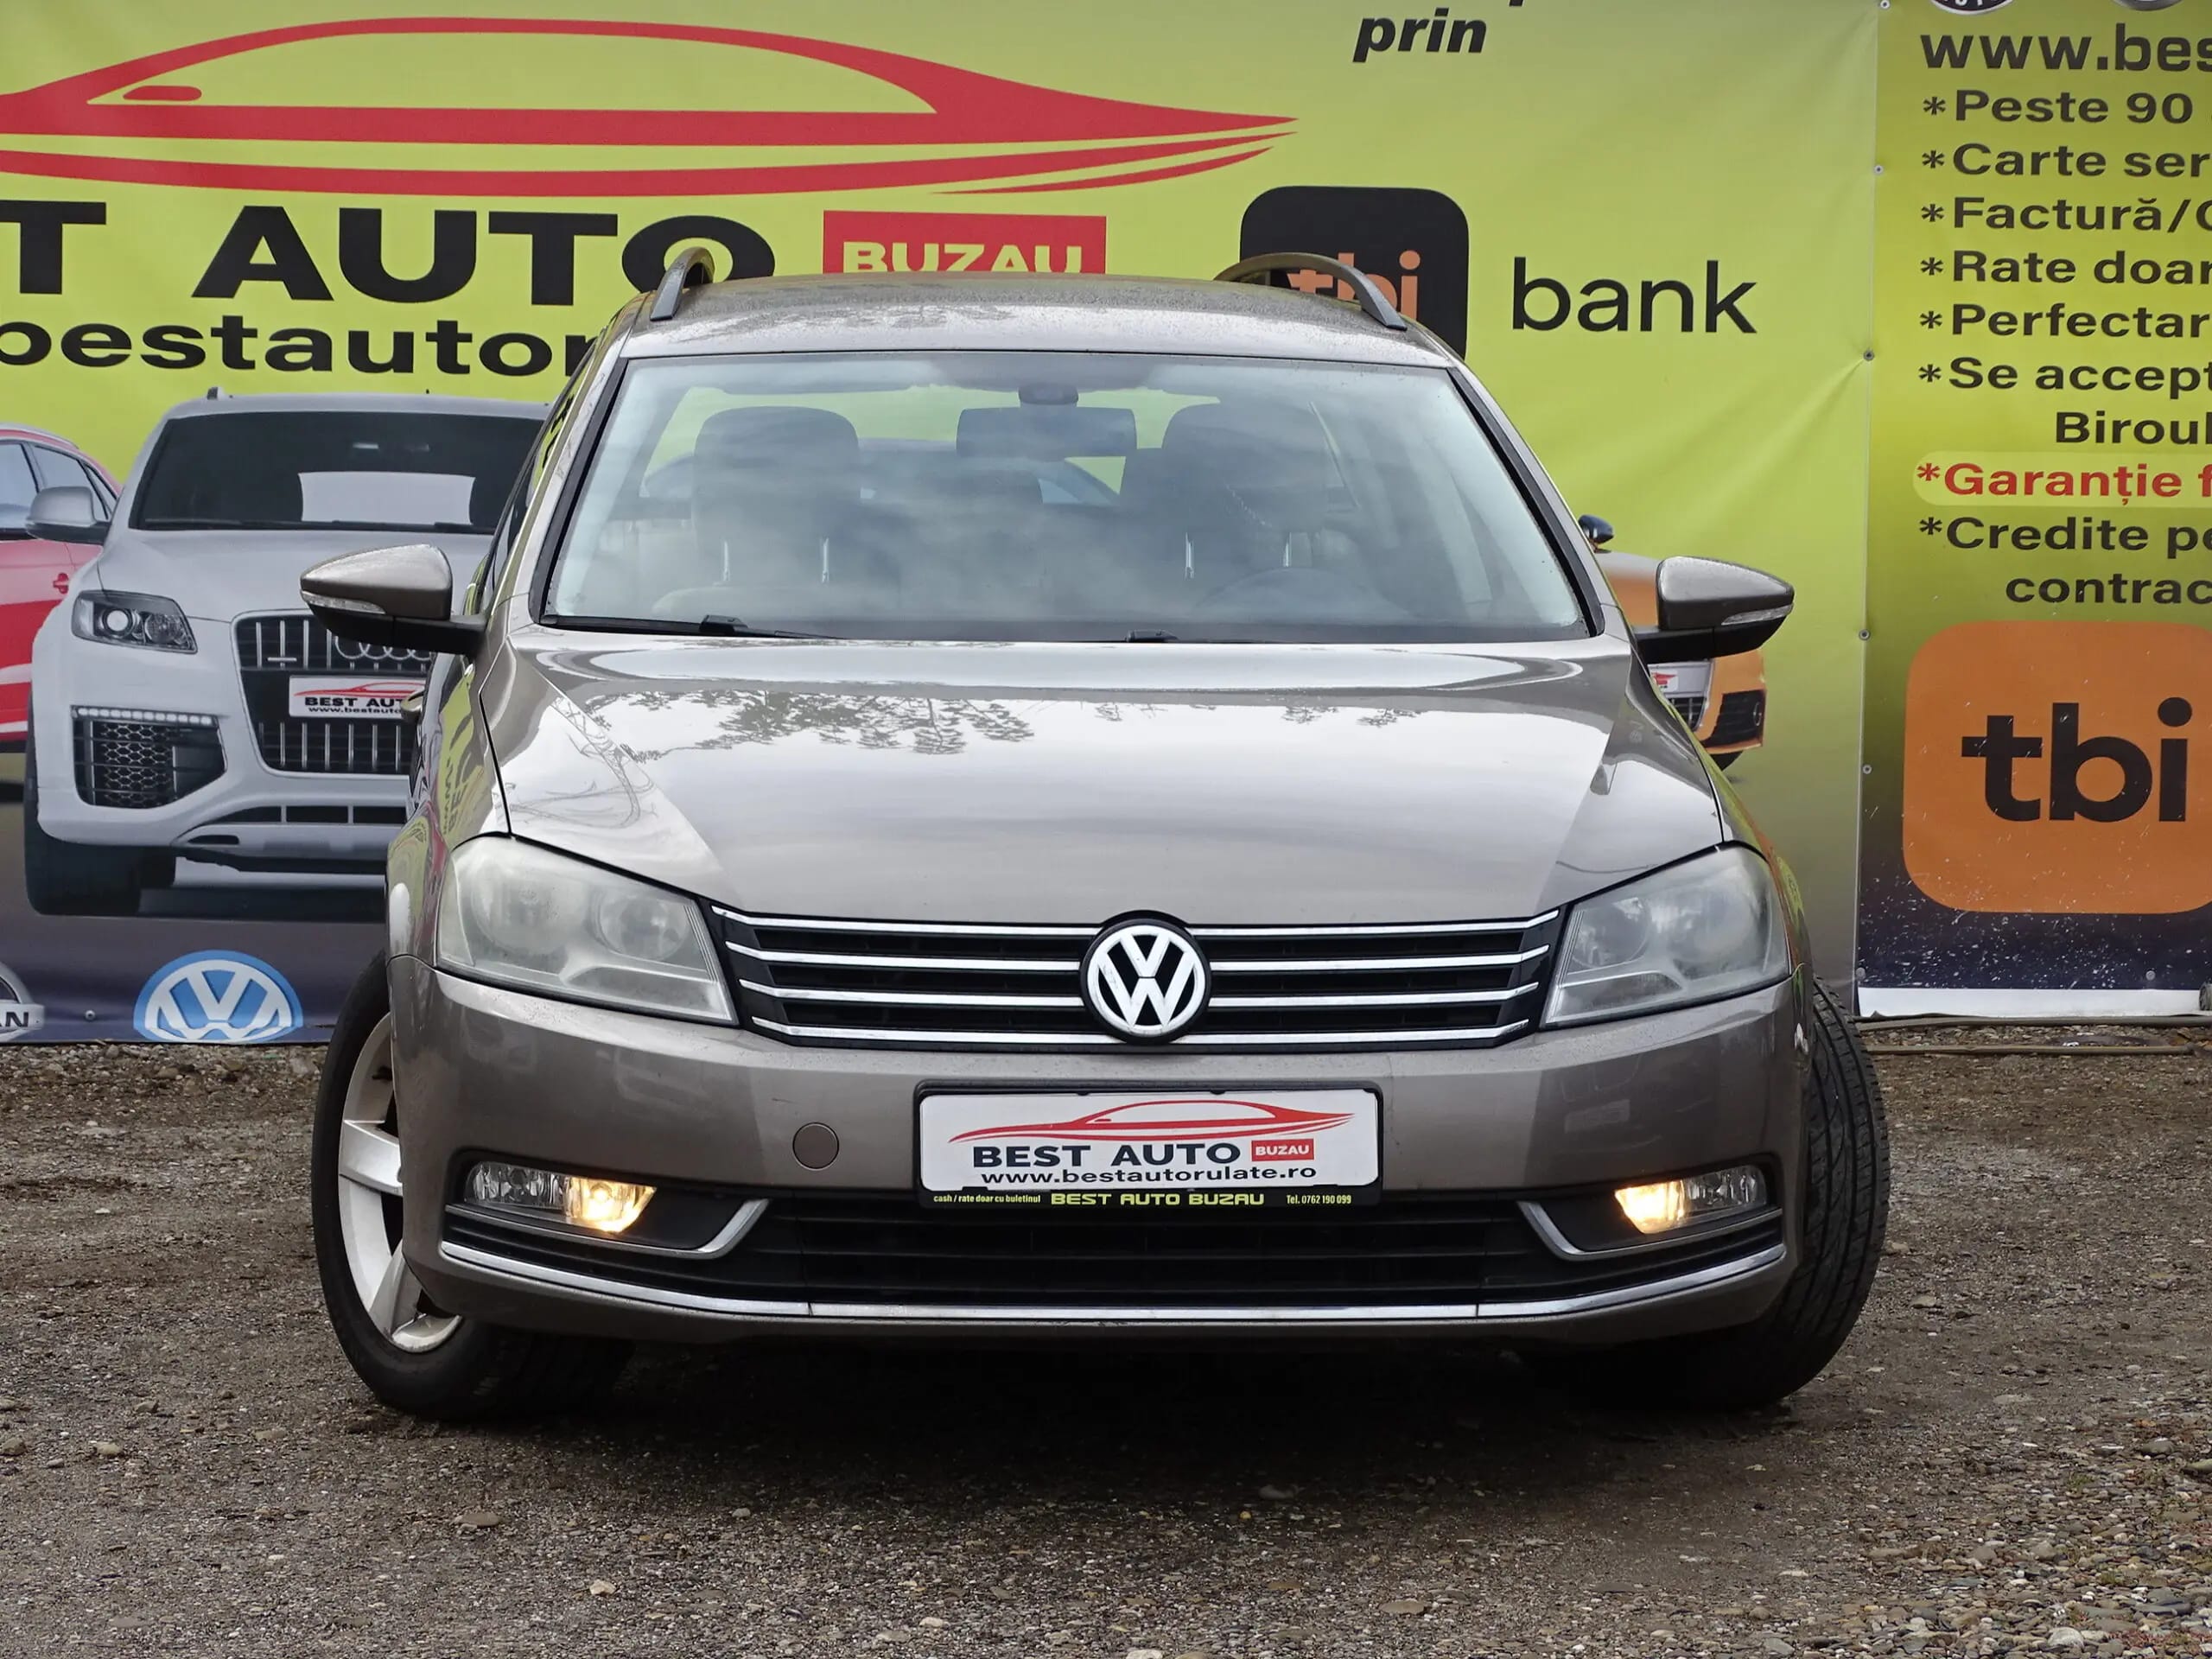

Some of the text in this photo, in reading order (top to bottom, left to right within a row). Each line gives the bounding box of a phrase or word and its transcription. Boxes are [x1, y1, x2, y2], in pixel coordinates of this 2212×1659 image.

[1352, 8, 1487, 62] prin
[2126, 92, 2193, 124] 90
[2124, 152, 2211, 177] ser
[192, 206, 776, 305] AUTO
[842, 241, 1082, 273] BUZAU
[1512, 257, 1757, 334] bank
[2005, 573, 2212, 604] contrac
[305, 696, 358, 707] BEST
[1961, 696, 2192, 823] tbi
[973, 1143, 1310, 1168] BEST AUTO BUZAU
[981, 1166, 1317, 1184] www.bestautorulate.ro
[933, 1194, 952, 1203] cash
[958, 1194, 975, 1203] rate
[976, 1194, 994, 1203] doar
[1051, 1193, 1112, 1205] BEST
[1120, 1193, 1180, 1205] AUTO
[1188, 1193, 1265, 1205] BUZAU
[1286, 1194, 1300, 1205] Tel.
[1301, 1194, 1320, 1205] 0762
[1322, 1194, 1335, 1205] 190
[1336, 1194, 1351, 1205] 099
